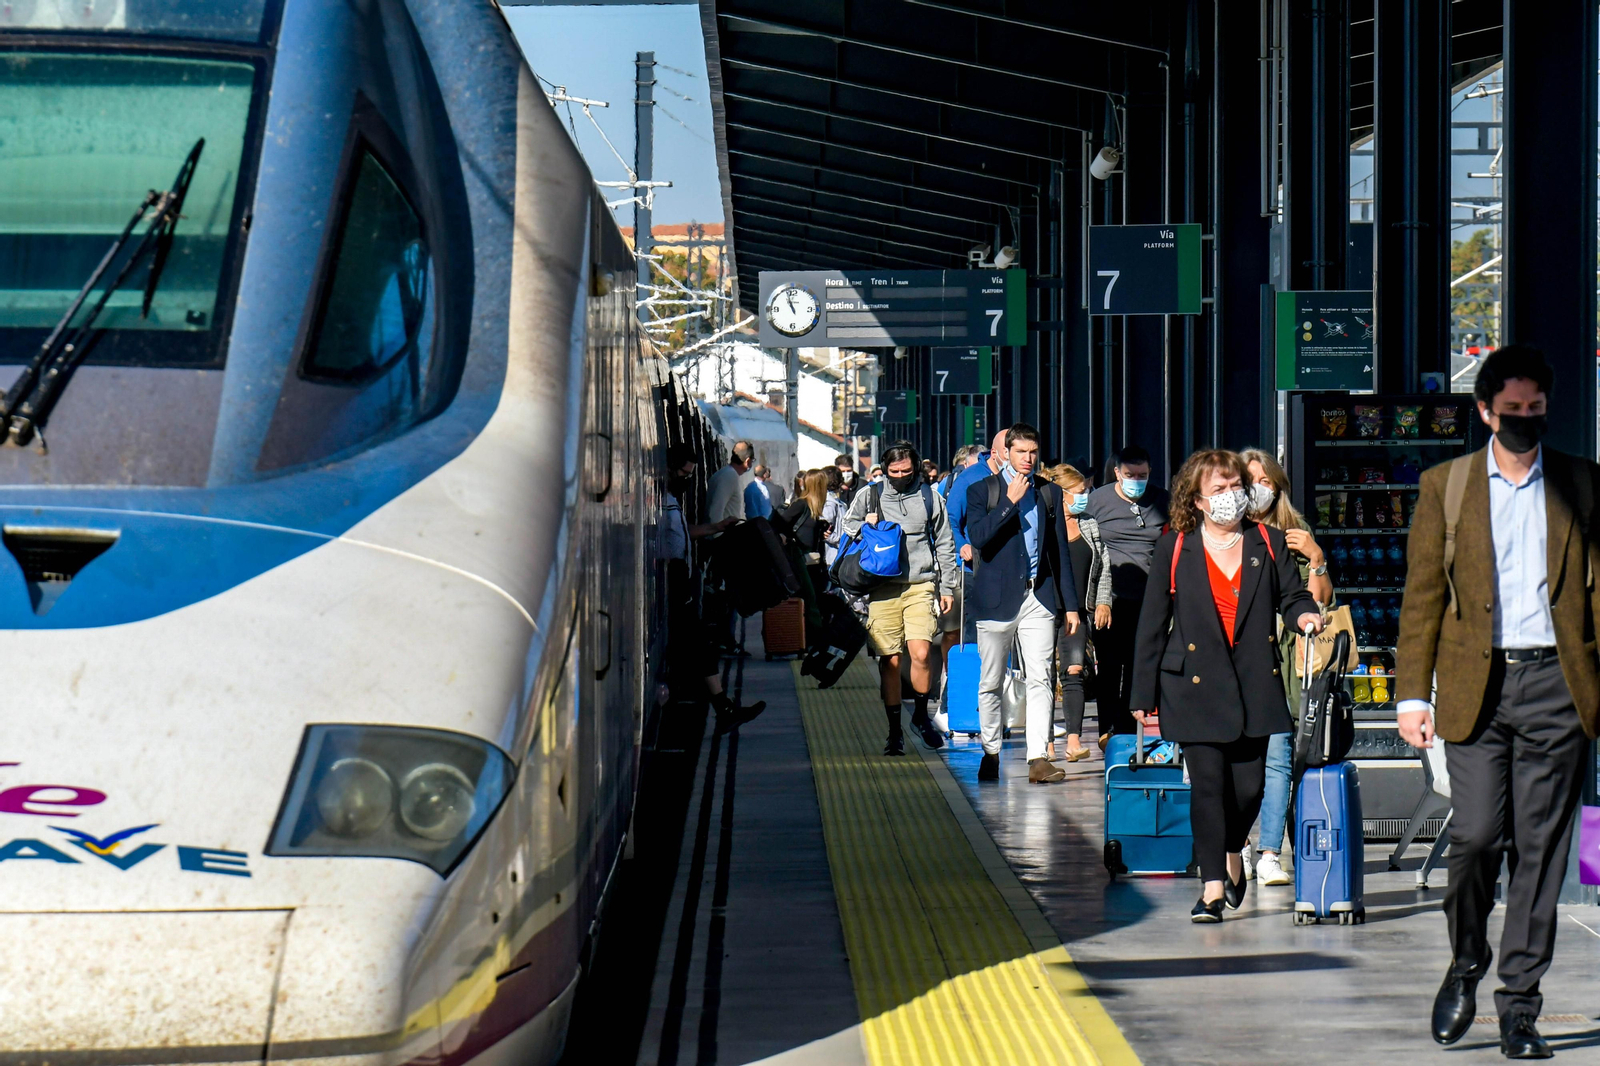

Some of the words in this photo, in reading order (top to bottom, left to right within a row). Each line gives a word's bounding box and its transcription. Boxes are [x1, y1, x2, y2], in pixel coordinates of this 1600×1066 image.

[1160, 229, 1174, 239] Vía
[825, 278, 844, 286] Hora
[870, 278, 888, 286] Tren
[991, 276, 1004, 284] Vía
[1096, 270, 1120, 310] 7
[826, 302, 854, 310] Destino
[985, 309, 1004, 337] 7
[936, 370, 949, 392] 7
[877, 406, 888, 422] 7
[1320, 408, 1346, 417] Doritos
[851, 422, 858, 435] 7
[1375, 737, 1411, 748] PUS
[0, 836, 253, 878] AVE
